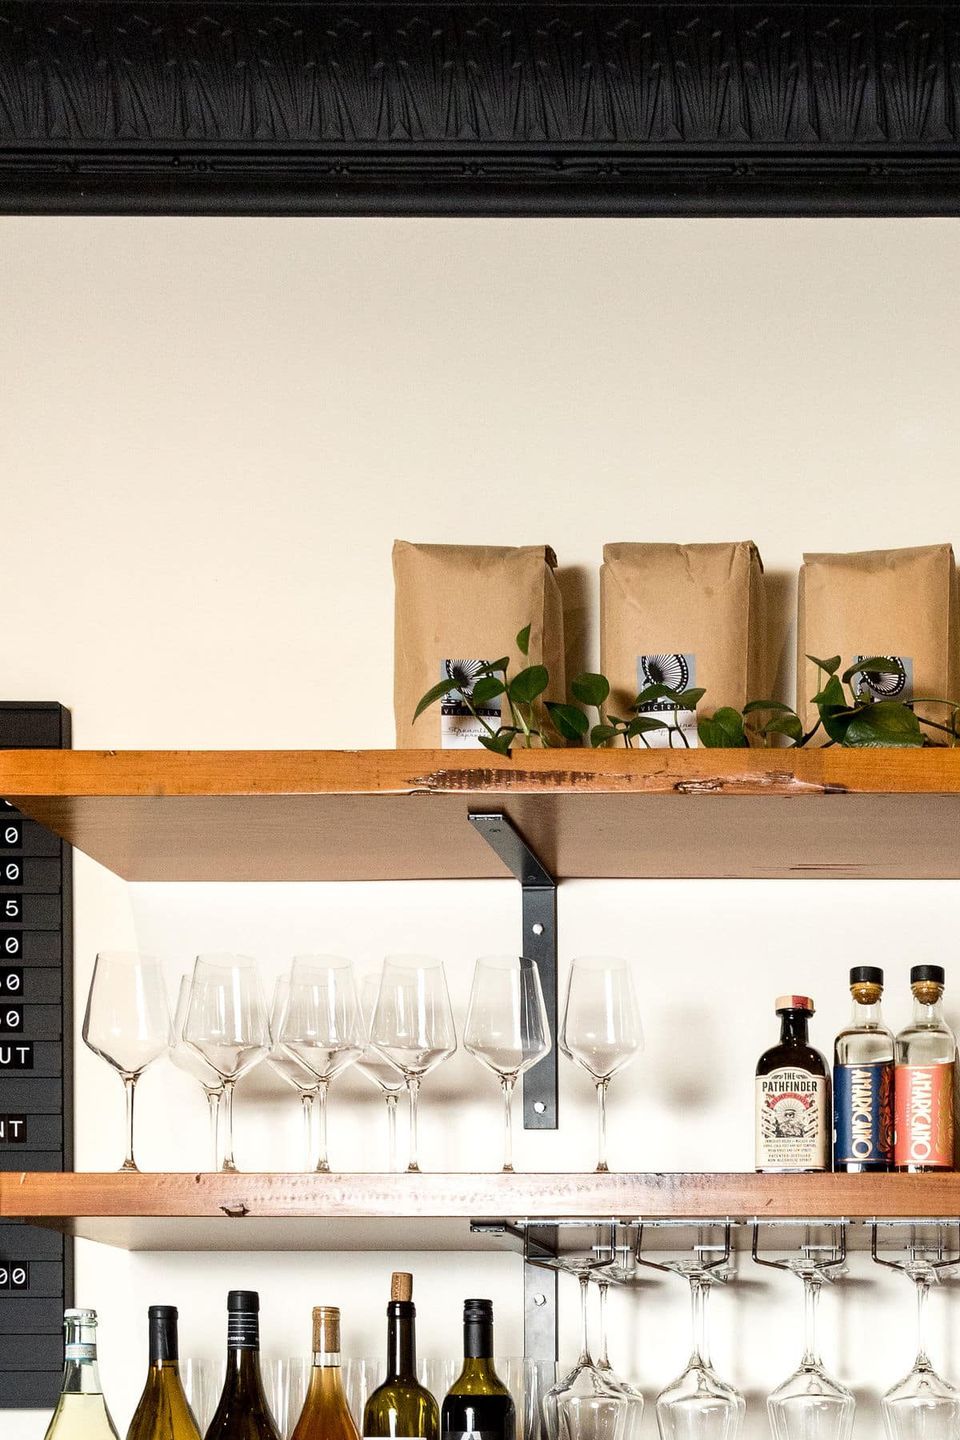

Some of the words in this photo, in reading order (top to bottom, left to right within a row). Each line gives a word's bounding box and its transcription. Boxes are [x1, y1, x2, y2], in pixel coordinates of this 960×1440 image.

[443, 708, 499, 716] VICTOLA
[0, 863, 19, 879] 0
[5, 900, 18, 916] 5
[0, 974, 19, 990] 0
[0, 1011, 19, 1027] 0
[0, 1047, 30, 1064] UT
[762, 1081, 818, 1092] PATHFINDER
